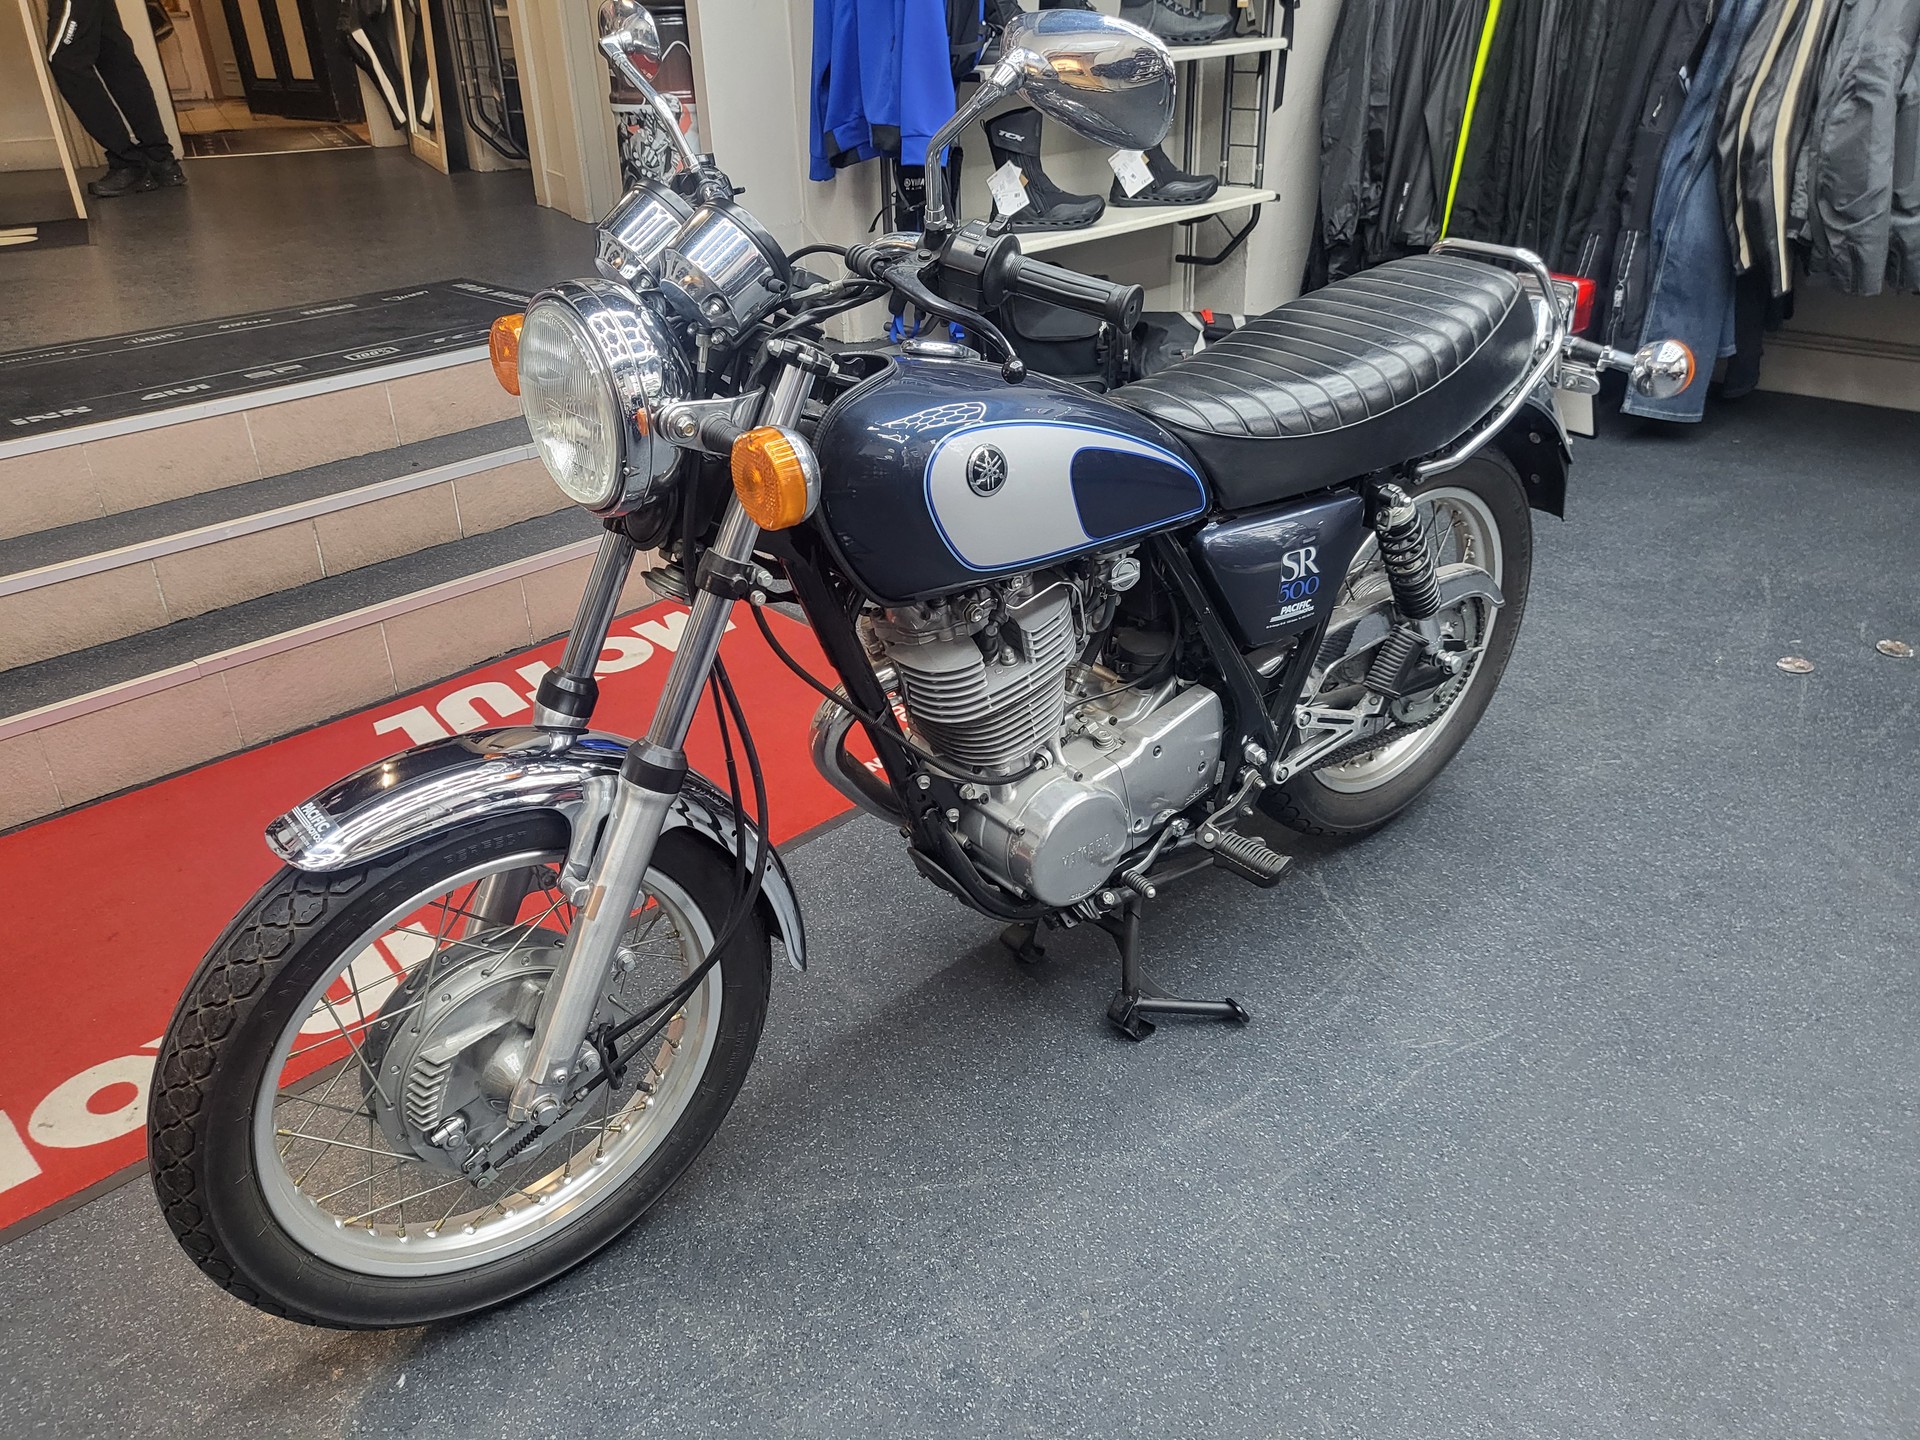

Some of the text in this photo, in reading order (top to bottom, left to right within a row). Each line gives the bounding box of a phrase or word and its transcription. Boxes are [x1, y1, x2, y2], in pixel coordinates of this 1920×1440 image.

[998, 129, 1025, 142] TCX
[141, 383, 211, 401] GIVI
[1281, 546, 1320, 582] SR
[1278, 576, 1320, 604] 500
[1280, 598, 1313, 616] PACIFIC
[300, 801, 331, 833] PACIFIC
[306, 824, 324, 843] MOTOS
